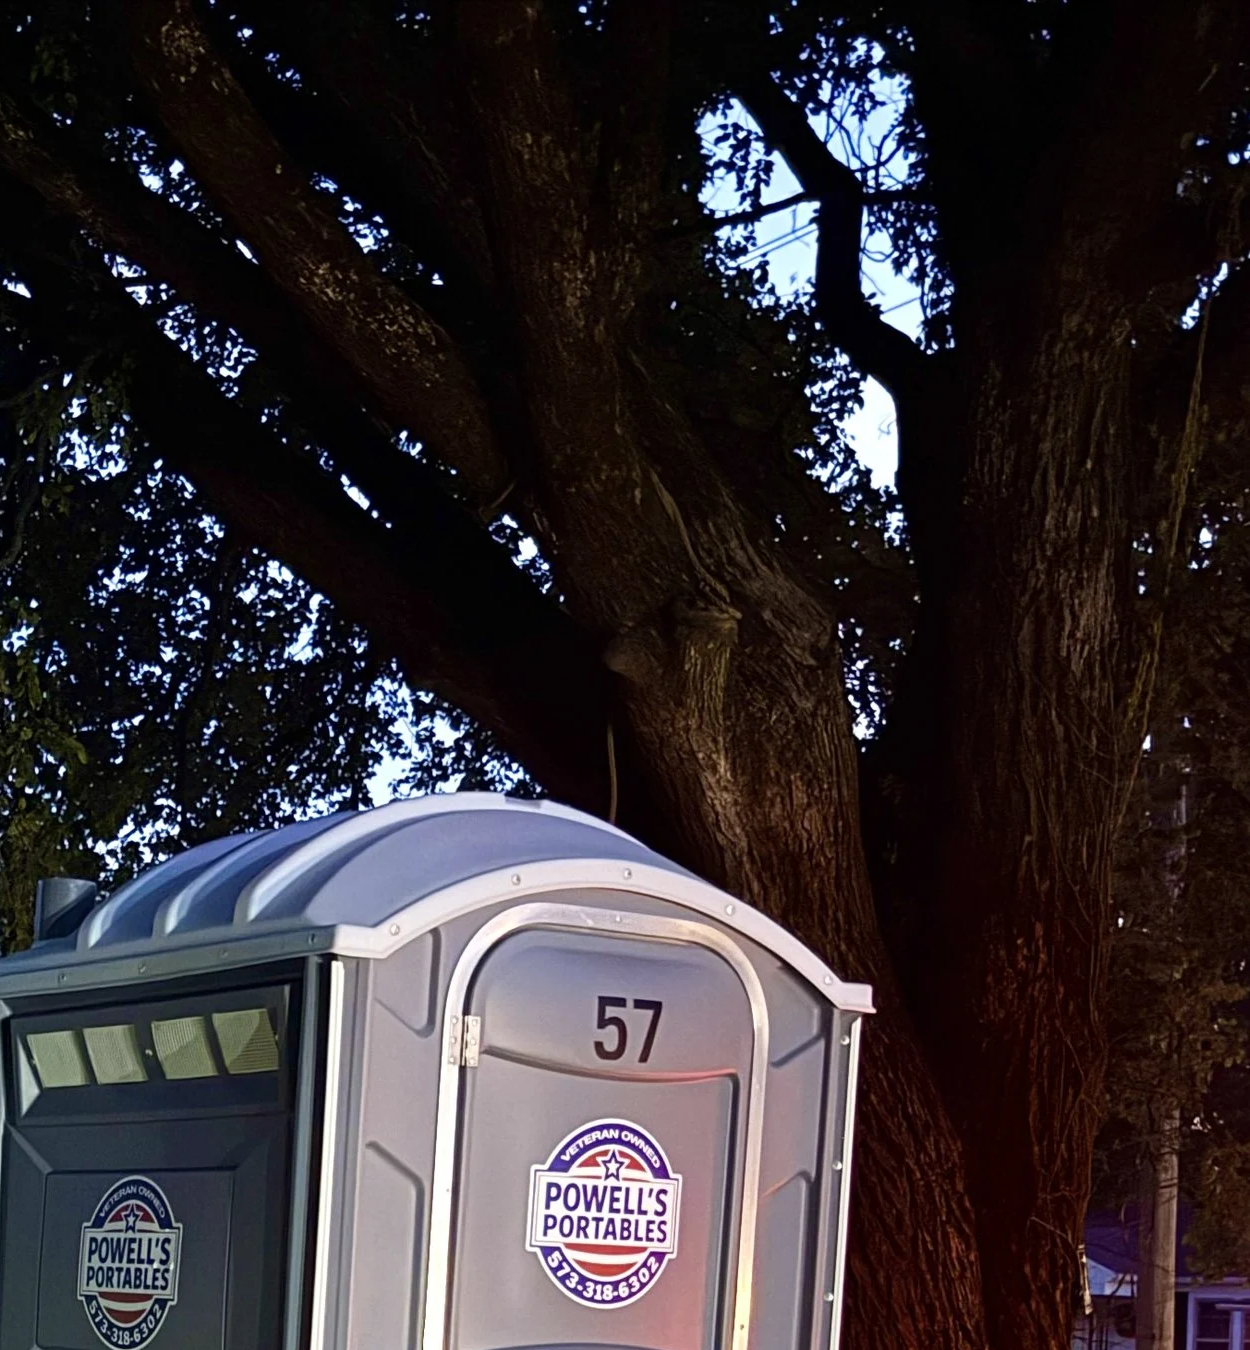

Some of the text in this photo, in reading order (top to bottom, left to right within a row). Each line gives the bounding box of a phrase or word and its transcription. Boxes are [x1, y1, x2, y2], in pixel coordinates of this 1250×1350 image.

[593, 996, 662, 1063] 57
[561, 1129, 661, 1169] VETERAN OWNED
[99, 1185, 166, 1219] VETERAN OWNED
[544, 1182, 668, 1216] POWELL'S
[542, 1214, 667, 1243] PORTABLES
[88, 1236, 171, 1266] POWELL'S
[86, 1266, 170, 1291] PORTABLES
[547, 1252, 659, 1301] 573-318-6302
[88, 1301, 162, 1345] 573-318-6302
